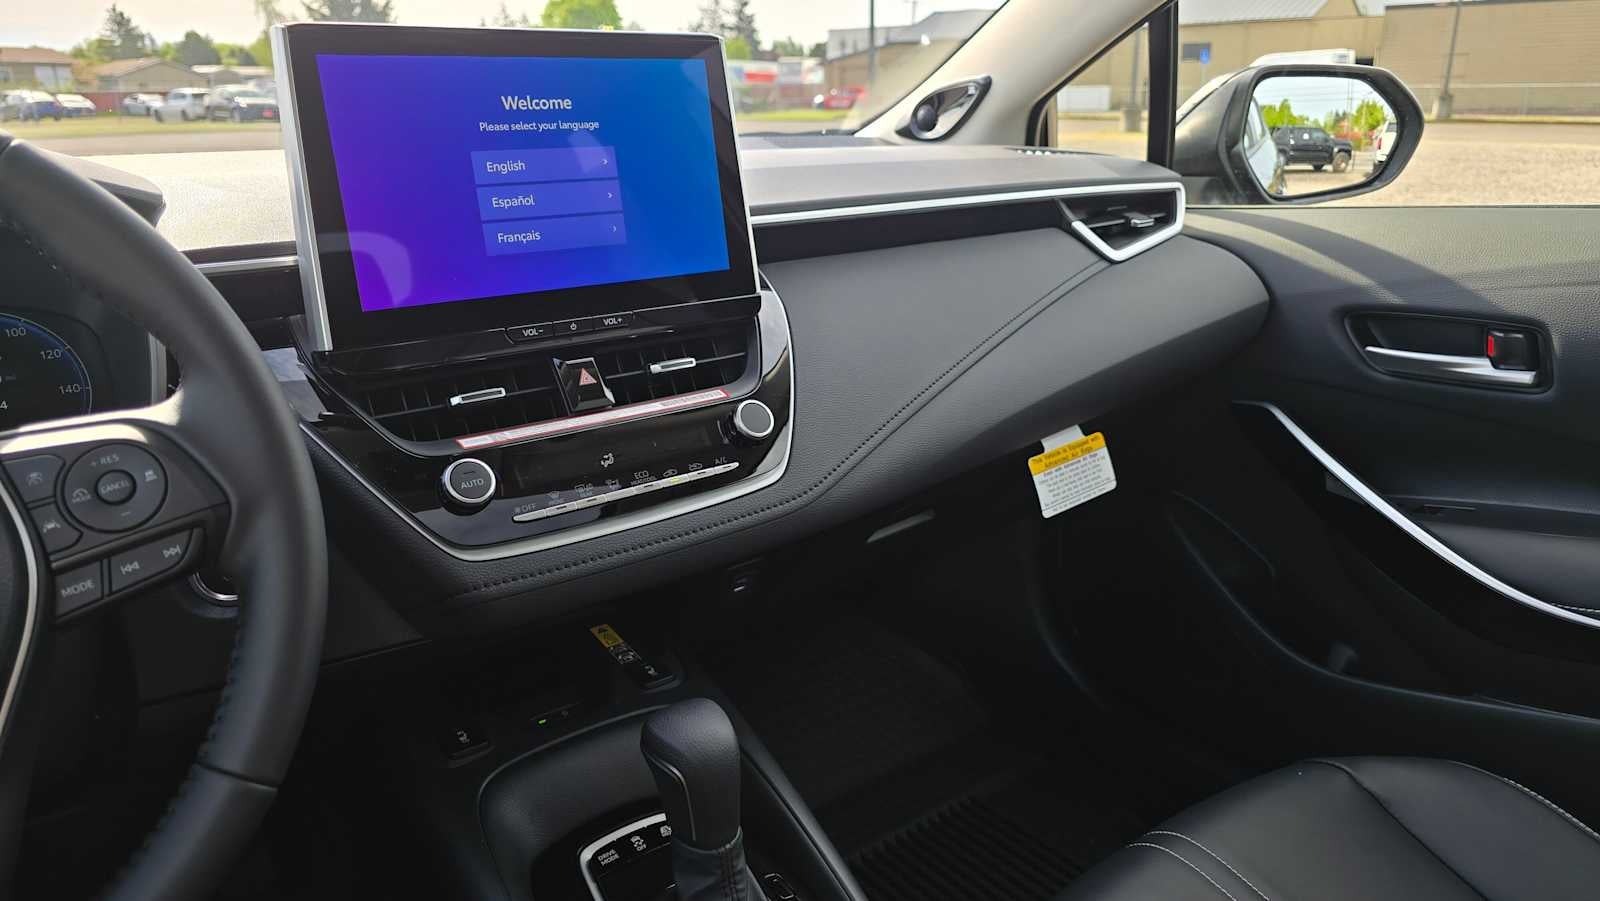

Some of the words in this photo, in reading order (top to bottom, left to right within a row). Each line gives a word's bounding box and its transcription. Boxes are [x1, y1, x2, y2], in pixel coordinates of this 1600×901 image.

[501, 95, 573, 110] Welcome
[479, 121, 510, 132] Please
[510, 121, 537, 131] select
[538, 122, 557, 132] your
[559, 120, 600, 131] language
[486, 160, 526, 175] English
[492, 194, 536, 209] Español
[497, 230, 542, 244] Français
[5, 327, 26, 337] 100
[40, 348, 61, 360] 120
[59, 383, 81, 394] 140
[100, 454, 120, 465] RES
[715, 457, 728, 465] A/C
[634, 470, 650, 480] ECO
[101, 480, 130, 494] CANCEL
[461, 478, 485, 489] AUTO
[521, 502, 538, 512] OFF
[61, 579, 96, 598] MODE
[598, 848, 617, 861] DRIVE
[601, 853, 620, 866] MODE
